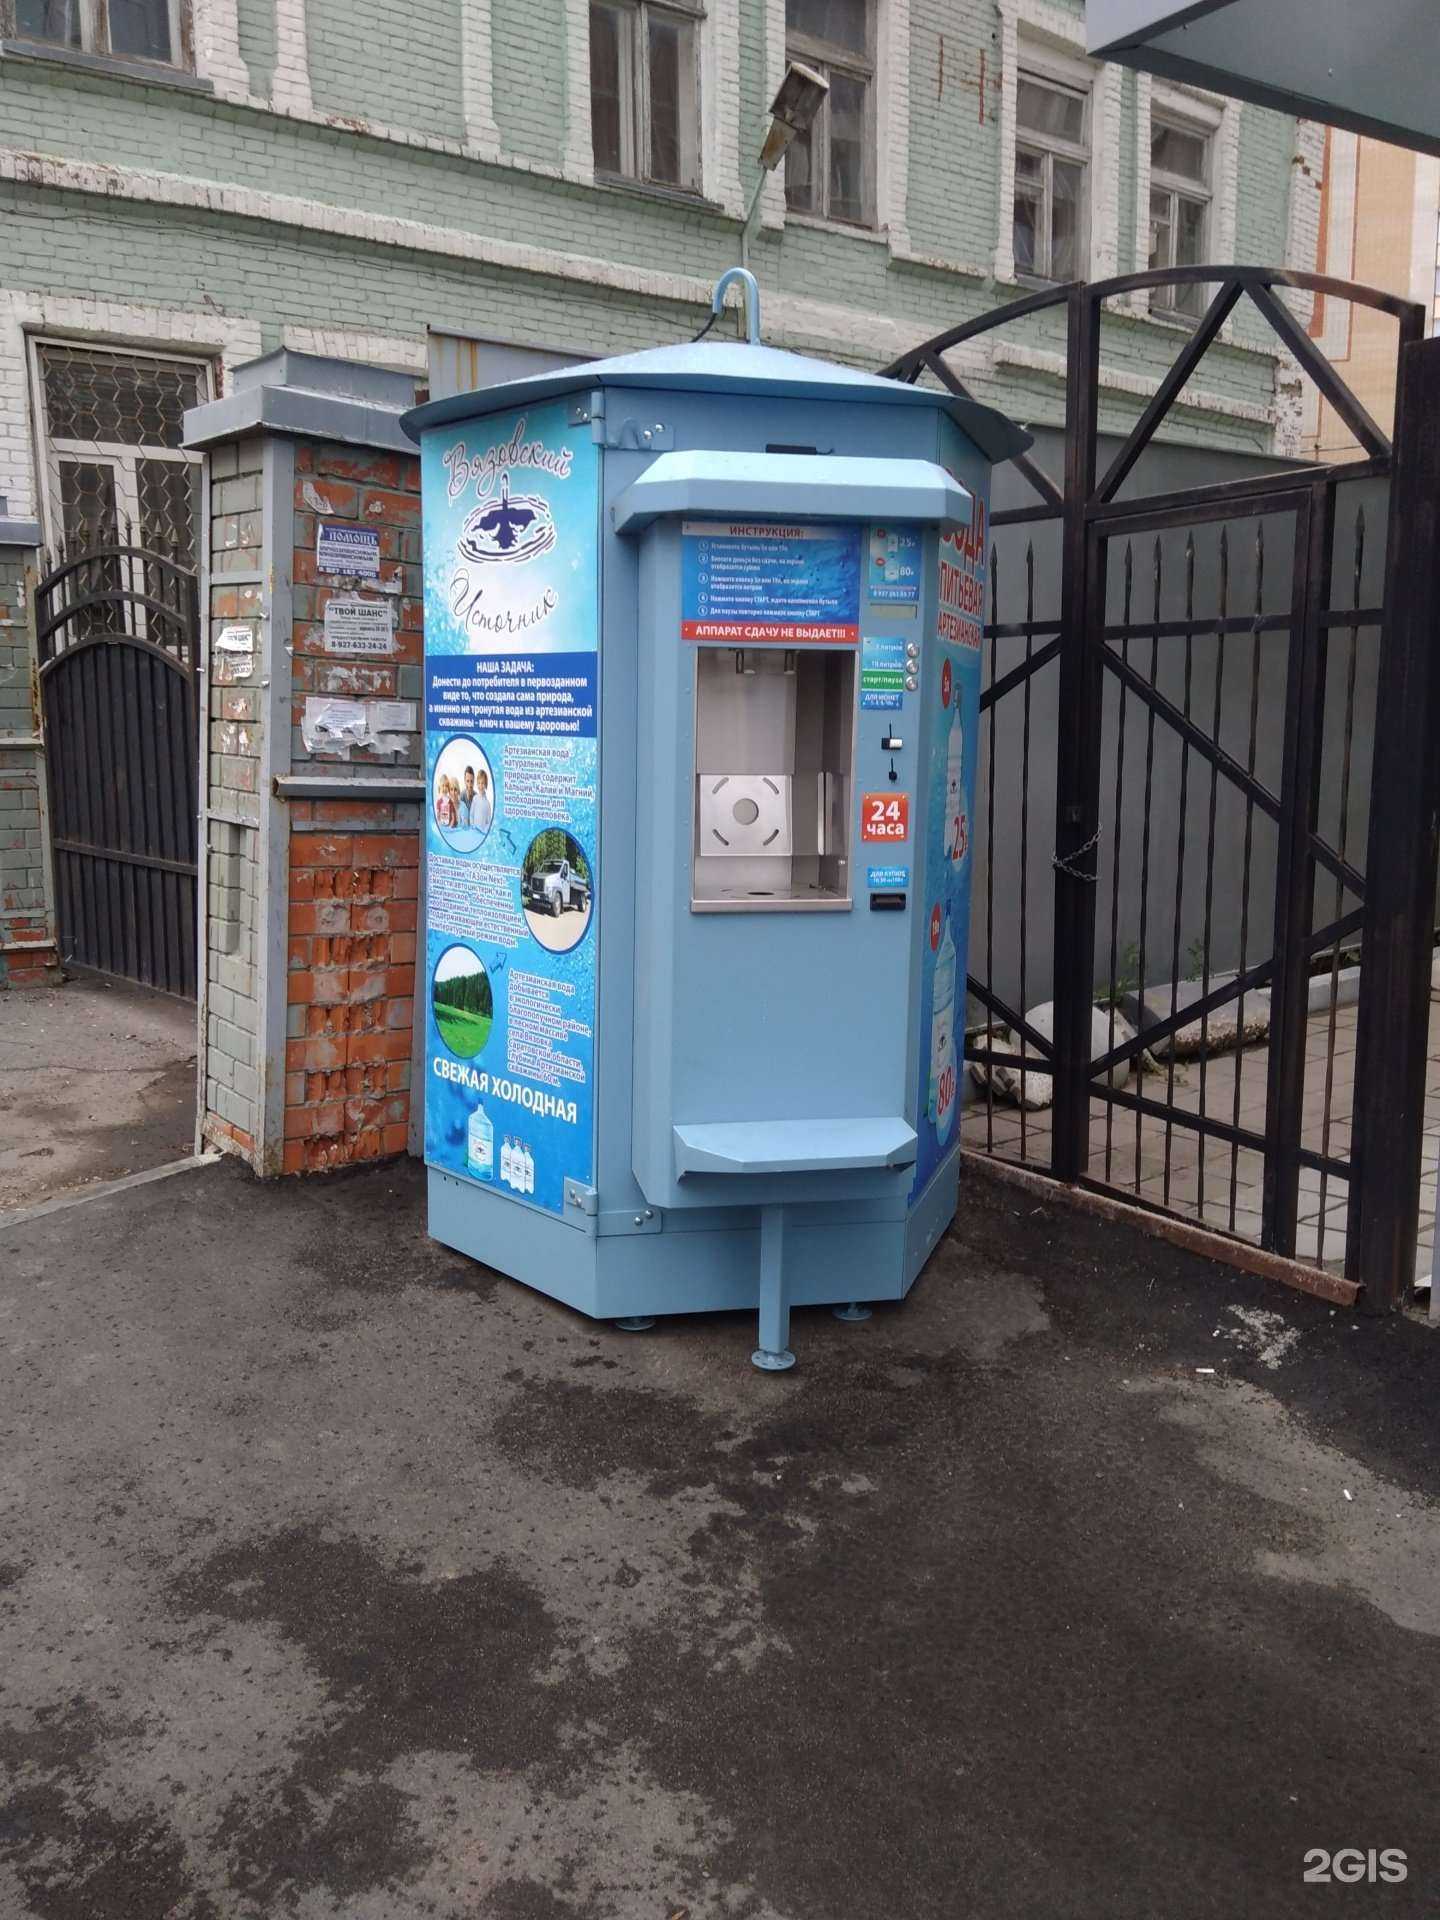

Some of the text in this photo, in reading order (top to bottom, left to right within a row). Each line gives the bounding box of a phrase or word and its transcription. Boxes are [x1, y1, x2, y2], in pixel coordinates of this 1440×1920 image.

[444, 418, 573, 496] Вязовский
[329, 531, 377, 546] ПОМОЩЬ
[730, 526, 805, 539] ИНСТРУКЦИЯ:
[940, 561, 984, 616] ПИТЬЕВАЯ
[450, 568, 556, 634] Источник
[696, 626, 741, 636] АППАРАТ
[744, 626, 778, 638] СДАЧУ
[781, 628, 794, 637] НЕ
[476, 661, 534, 673] НАША ЗАДАЧА:
[433, 676, 587, 690] Донести до потребителя в первозданном
[443, 692, 574, 705] виде то, что создала сама природа,
[434, 706, 460, 714] именно
[471, 706, 504, 716] тронутая
[505, 707, 524, 717] вода
[525, 707, 534, 715] из
[536, 705, 592, 719] артезианской
[439, 718, 474, 727] скважины
[479, 719, 498, 728] ключ
[505, 720, 534, 733] вашему
[536, 720, 580, 734] здоровью!
[505, 745, 569, 758] Артезианская вода
[542, 775, 576, 784] содержит
[871, 800, 900, 821] 24
[866, 823, 904, 835] часа
[434, 1056, 577, 1124] СВЕЖАЯ ХОЛОДНАЯ
